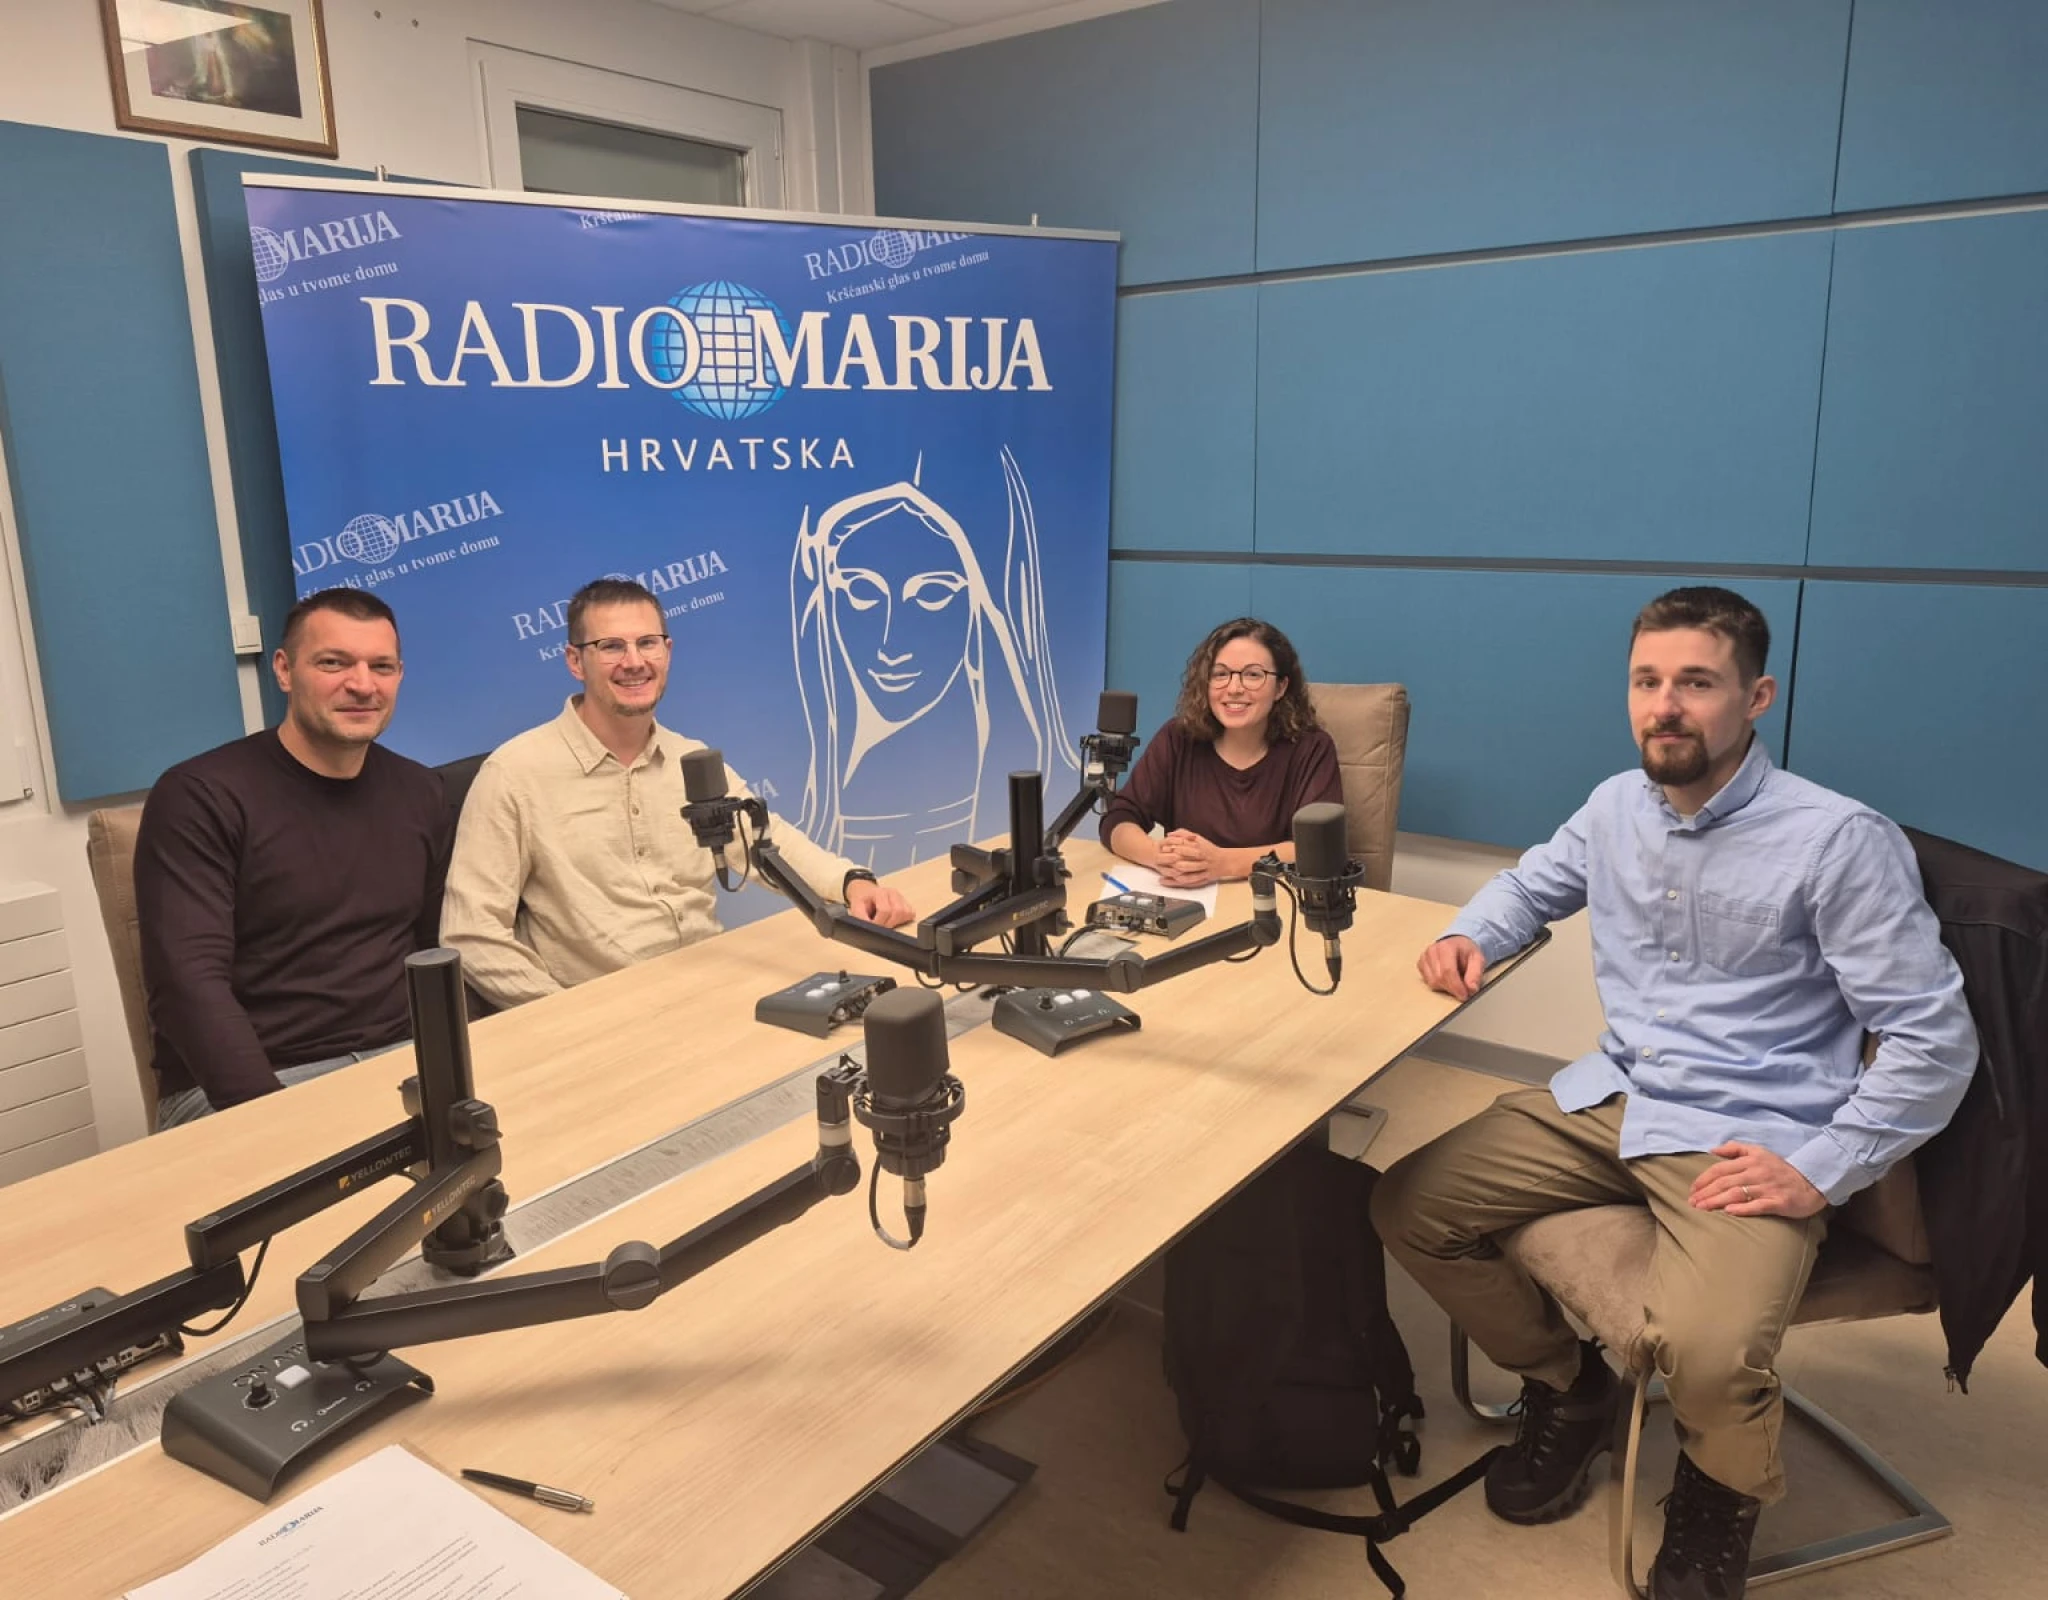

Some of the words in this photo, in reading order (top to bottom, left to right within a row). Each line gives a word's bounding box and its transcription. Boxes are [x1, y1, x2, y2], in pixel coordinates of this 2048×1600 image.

[263, 210, 403, 262] MARIJA
[804, 236, 890, 281] RADIO
[287, 284, 299, 297] u
[302, 272, 352, 293] tvome
[355, 261, 399, 281] domu
[826, 276, 886, 304] Kršćanski
[887, 270, 911, 291] glas
[913, 270, 921, 281] u
[923, 261, 957, 278] tvome
[959, 250, 990, 268] domu
[360, 296, 701, 390] RADIO
[744, 306, 1053, 391] MARIJA
[601, 437, 855, 472] HRVATSKA
[376, 490, 504, 547] MARIJA
[364, 566, 396, 588] glas
[399, 564, 409, 575] u
[411, 548, 457, 570] tvome
[459, 534, 501, 556] domu
[511, 599, 570, 641] RAD
[690, 591, 725, 611] domu
